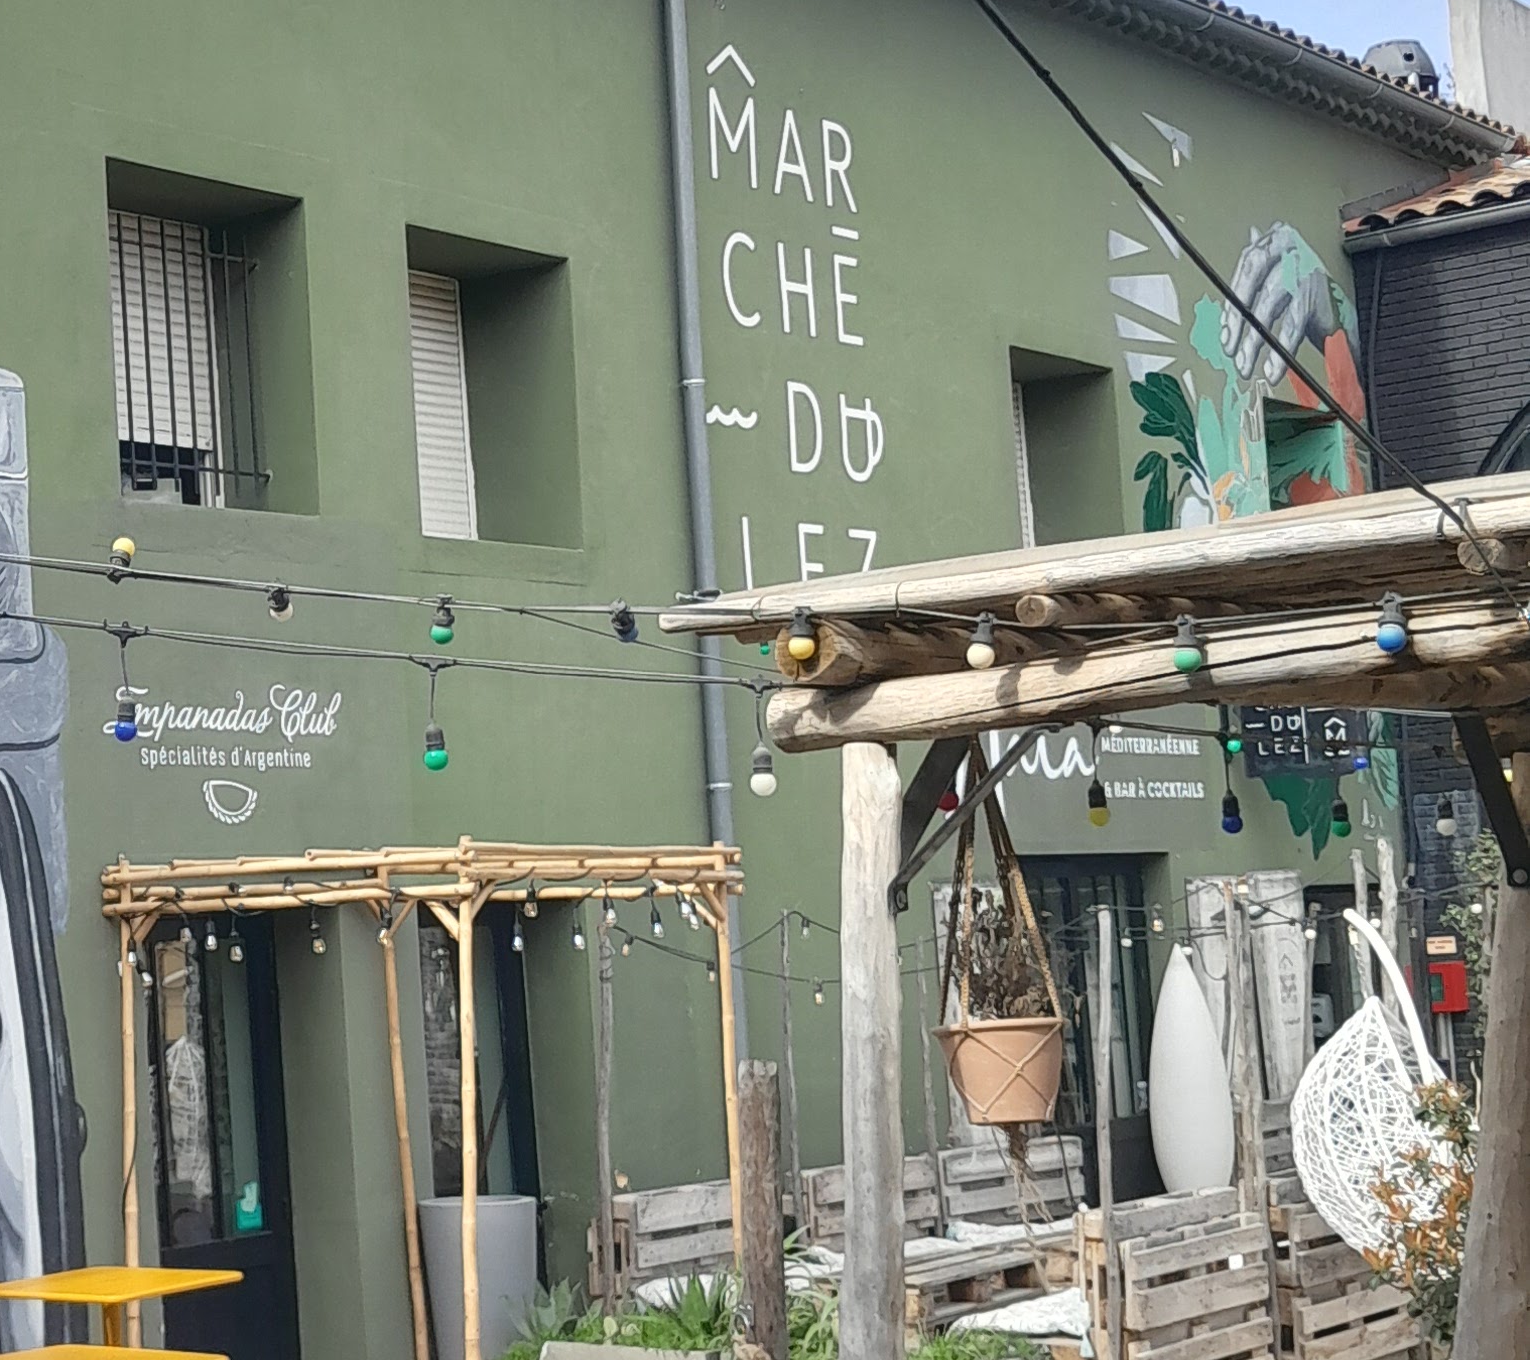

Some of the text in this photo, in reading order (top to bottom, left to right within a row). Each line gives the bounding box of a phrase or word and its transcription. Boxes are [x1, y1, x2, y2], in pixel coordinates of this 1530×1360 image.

[706, 86, 859, 214] MAR
[103, 684, 342, 743] Empanadas Club
[1101, 733, 1201, 755] MÉDITERRANÉENNE
[140, 745, 312, 771] Spécialités d'Argentine
[1113, 781, 1136, 798] BAR
[1146, 781, 1205, 799] COCKTAILS
